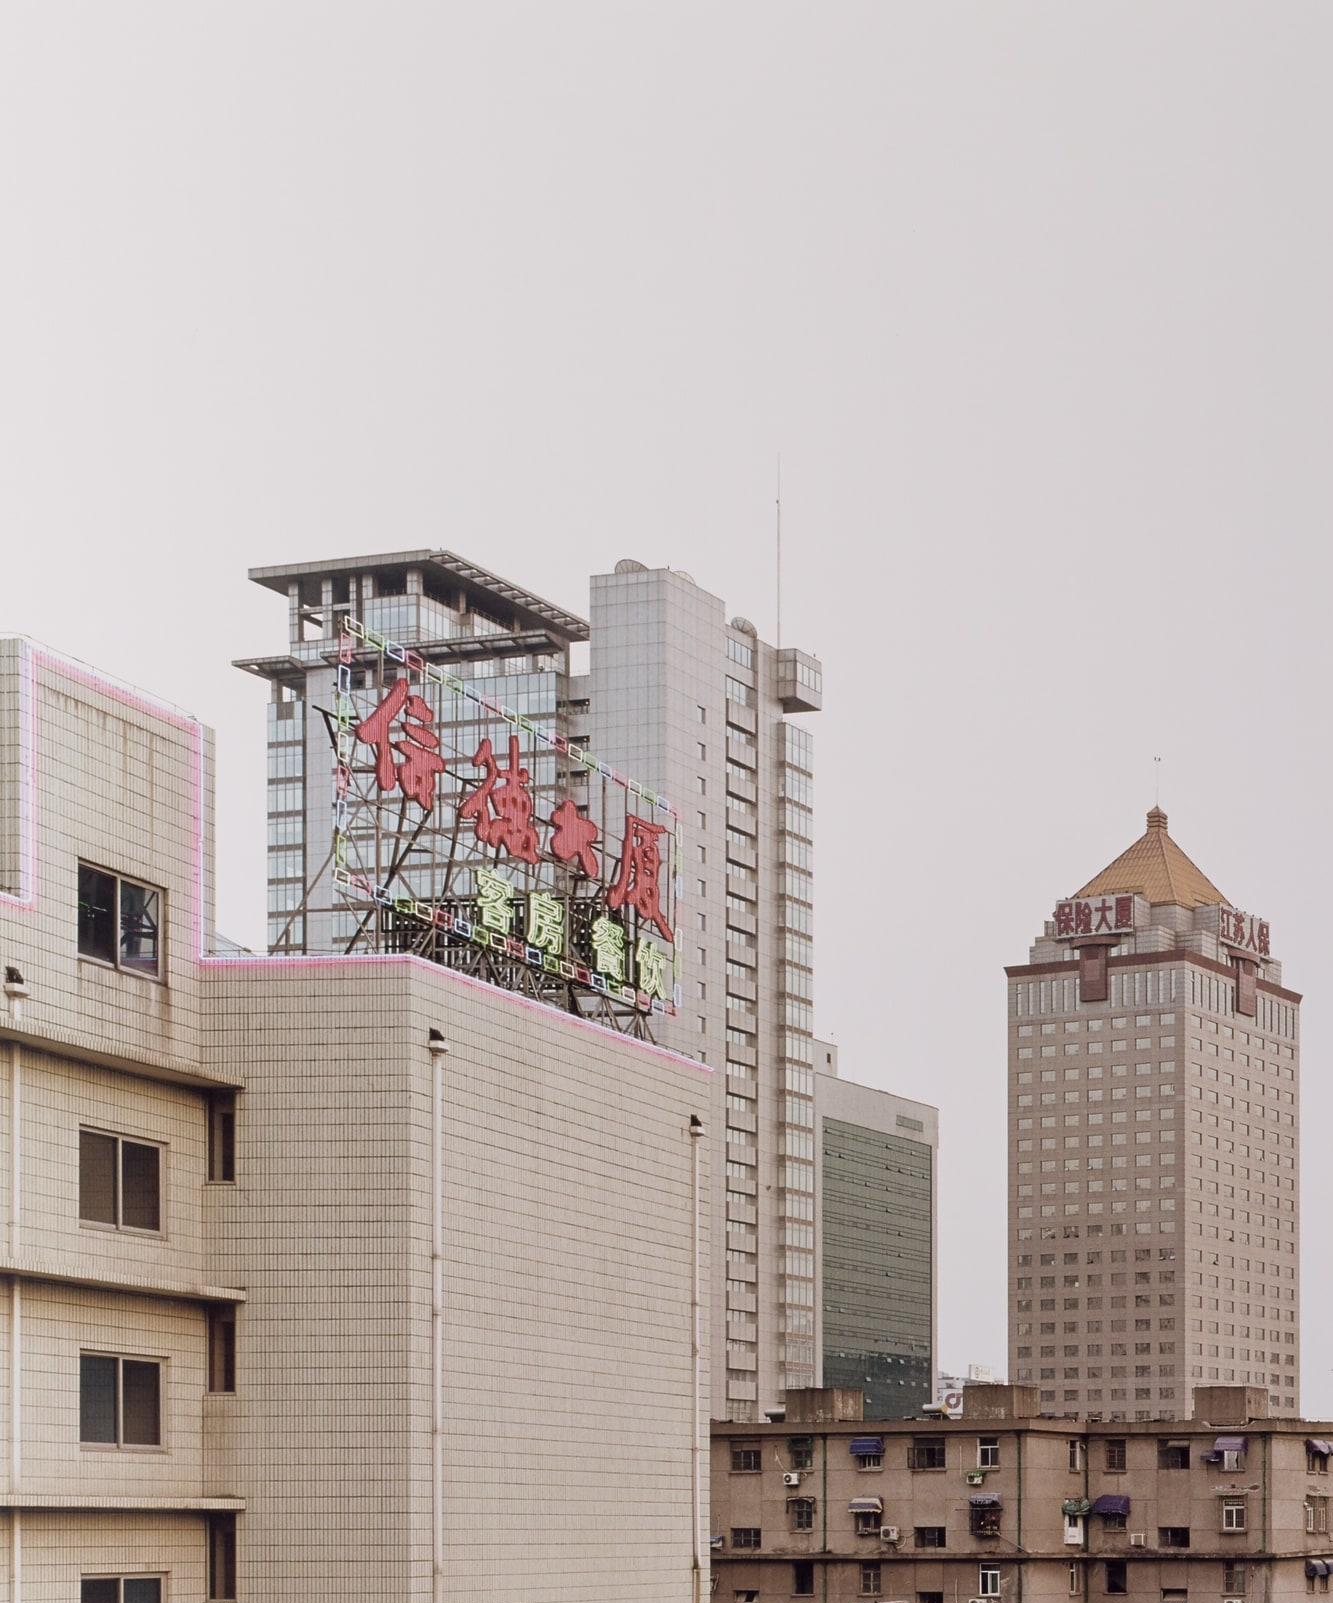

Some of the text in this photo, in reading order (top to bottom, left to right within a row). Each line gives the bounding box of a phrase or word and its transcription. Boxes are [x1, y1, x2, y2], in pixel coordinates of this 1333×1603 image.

[1053, 895, 1134, 936] 保险大厦
[1220, 907, 1271, 957] 江苏人保
